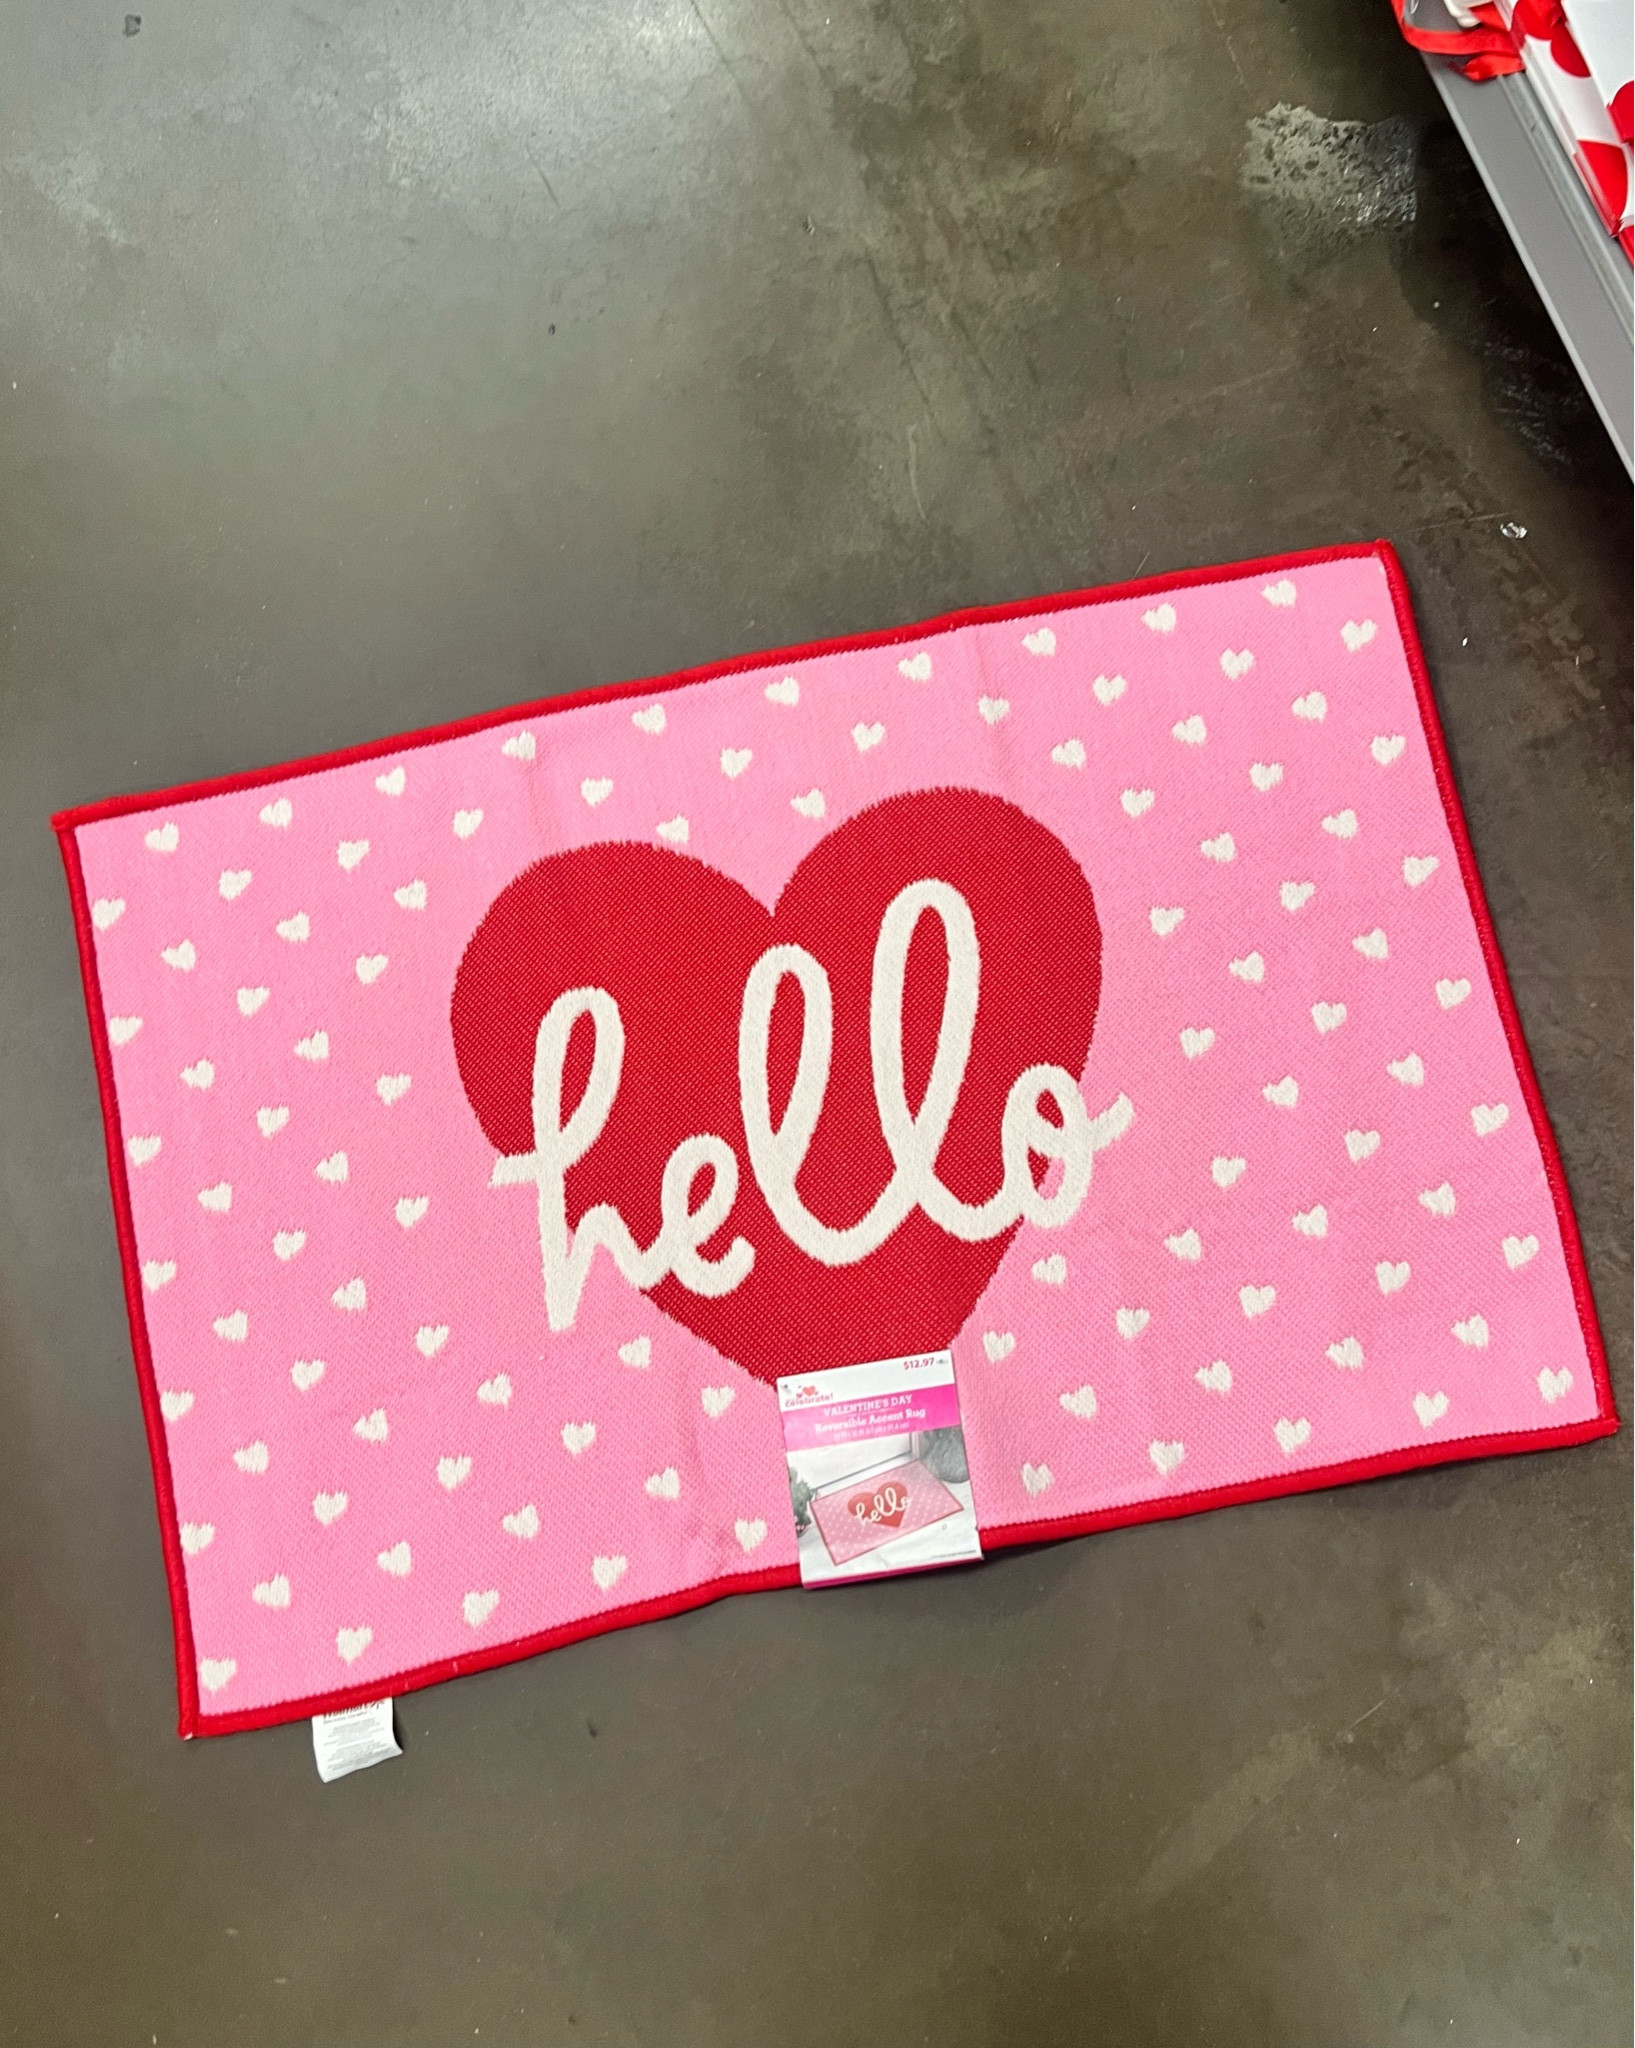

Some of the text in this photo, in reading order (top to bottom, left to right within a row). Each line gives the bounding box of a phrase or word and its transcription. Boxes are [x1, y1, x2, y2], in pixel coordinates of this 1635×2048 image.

[488, 878, 1135, 1331] hello
[904, 1357, 935, 1370] $12.97
[823, 1394, 913, 1417] VALENTINE'S DAY
[815, 1415, 867, 1433] Reversible
[869, 1411, 904, 1425] Accent
[905, 1408, 927, 1420] Rug
